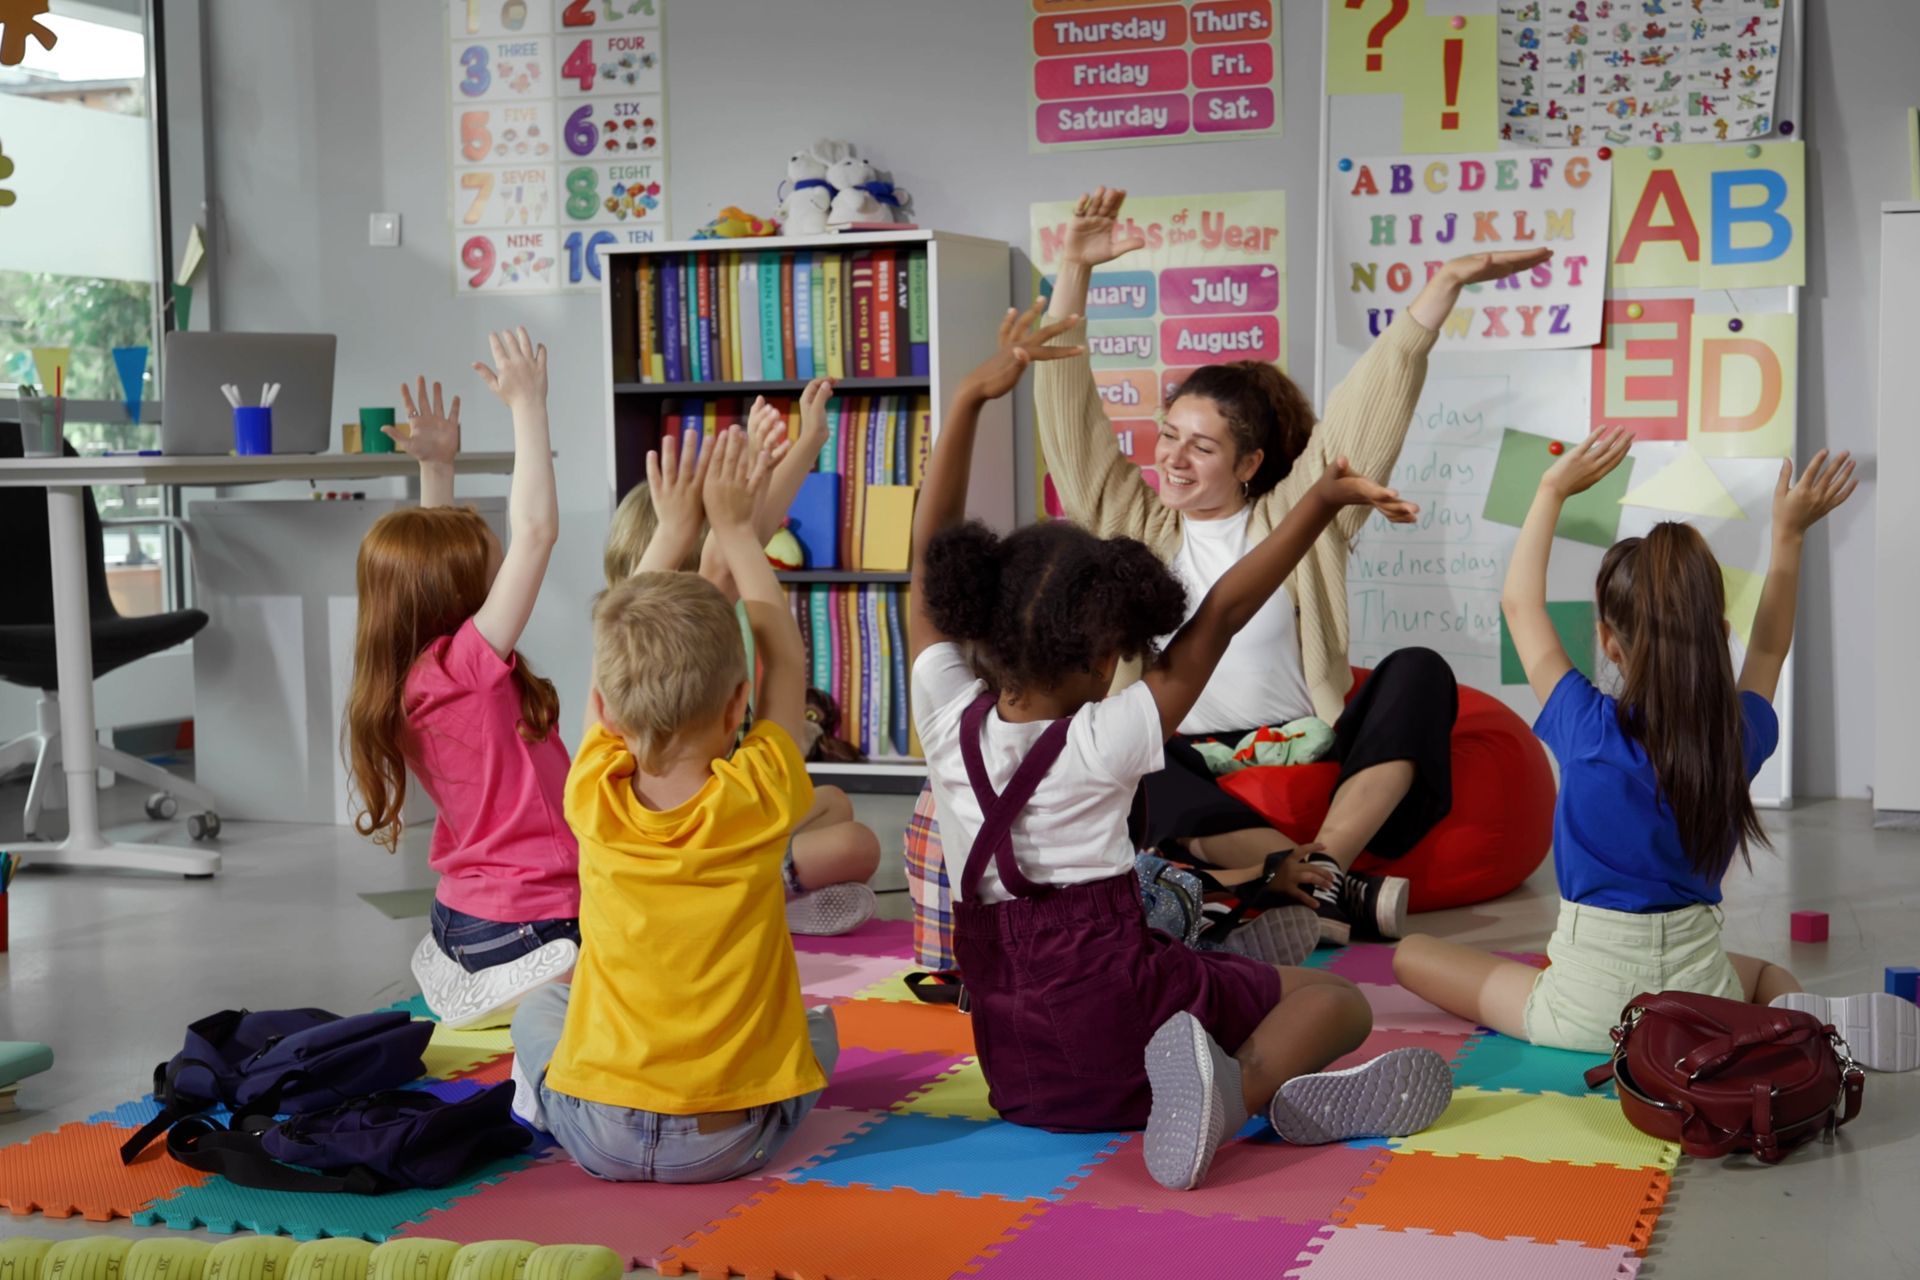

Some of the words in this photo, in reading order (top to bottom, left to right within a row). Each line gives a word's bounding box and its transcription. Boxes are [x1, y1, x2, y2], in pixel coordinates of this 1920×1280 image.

[1054, 17, 1166, 44] Thursday
[1193, 10, 1268, 32] Thurs.
[459, 45, 492, 97] 3
[497, 42, 538, 57] THREE
[561, 39, 596, 91] 4
[608, 37, 645, 51] FOUR
[1074, 62, 1148, 87] Friday
[1211, 54, 1252, 75] Fri.
[1058, 105, 1168, 130] Saturday
[1208, 96, 1258, 120] Sat.
[460, 110, 492, 161] 5
[504, 107, 537, 123] FIVE
[564, 104, 599, 156] 6
[614, 103, 640, 116] SIX
[461, 172, 495, 224] 7
[502, 170, 546, 184] SEVEN
[566, 166, 599, 220] 8
[609, 166, 652, 180] EIGHT
[1168, 228, 1197, 244] the
[1172, 208, 1189, 225] of
[1201, 210, 1279, 254] Year
[1615, 169, 1700, 264] A
[1711, 169, 1793, 265] B
[563, 231, 619, 283] 10
[629, 231, 653, 243] TEN
[1040, 217, 1163, 263] Mths
[461, 235, 496, 288] 9
[508, 234, 543, 248] NINE
[765, 258, 773, 298] BRAIN
[879, 261, 888, 301] WORLD
[797, 272, 808, 342] MEDICINE
[898, 271, 907, 308] LAW
[1087, 286, 1146, 308] uary
[1190, 277, 1248, 306] July
[765, 303, 774, 360] SURGERY
[859, 297, 869, 338] Book
[880, 311, 890, 362] HISTORY
[861, 343, 870, 371] Big
[1088, 336, 1152, 358] ruary
[1177, 327, 1263, 353] August
[1603, 321, 1679, 418] E
[1699, 338, 1783, 433] D
[1391, 451, 1474, 487] nday
[1355, 548, 1497, 579] Wednesday
[1354, 588, 1500, 640] Thursday
